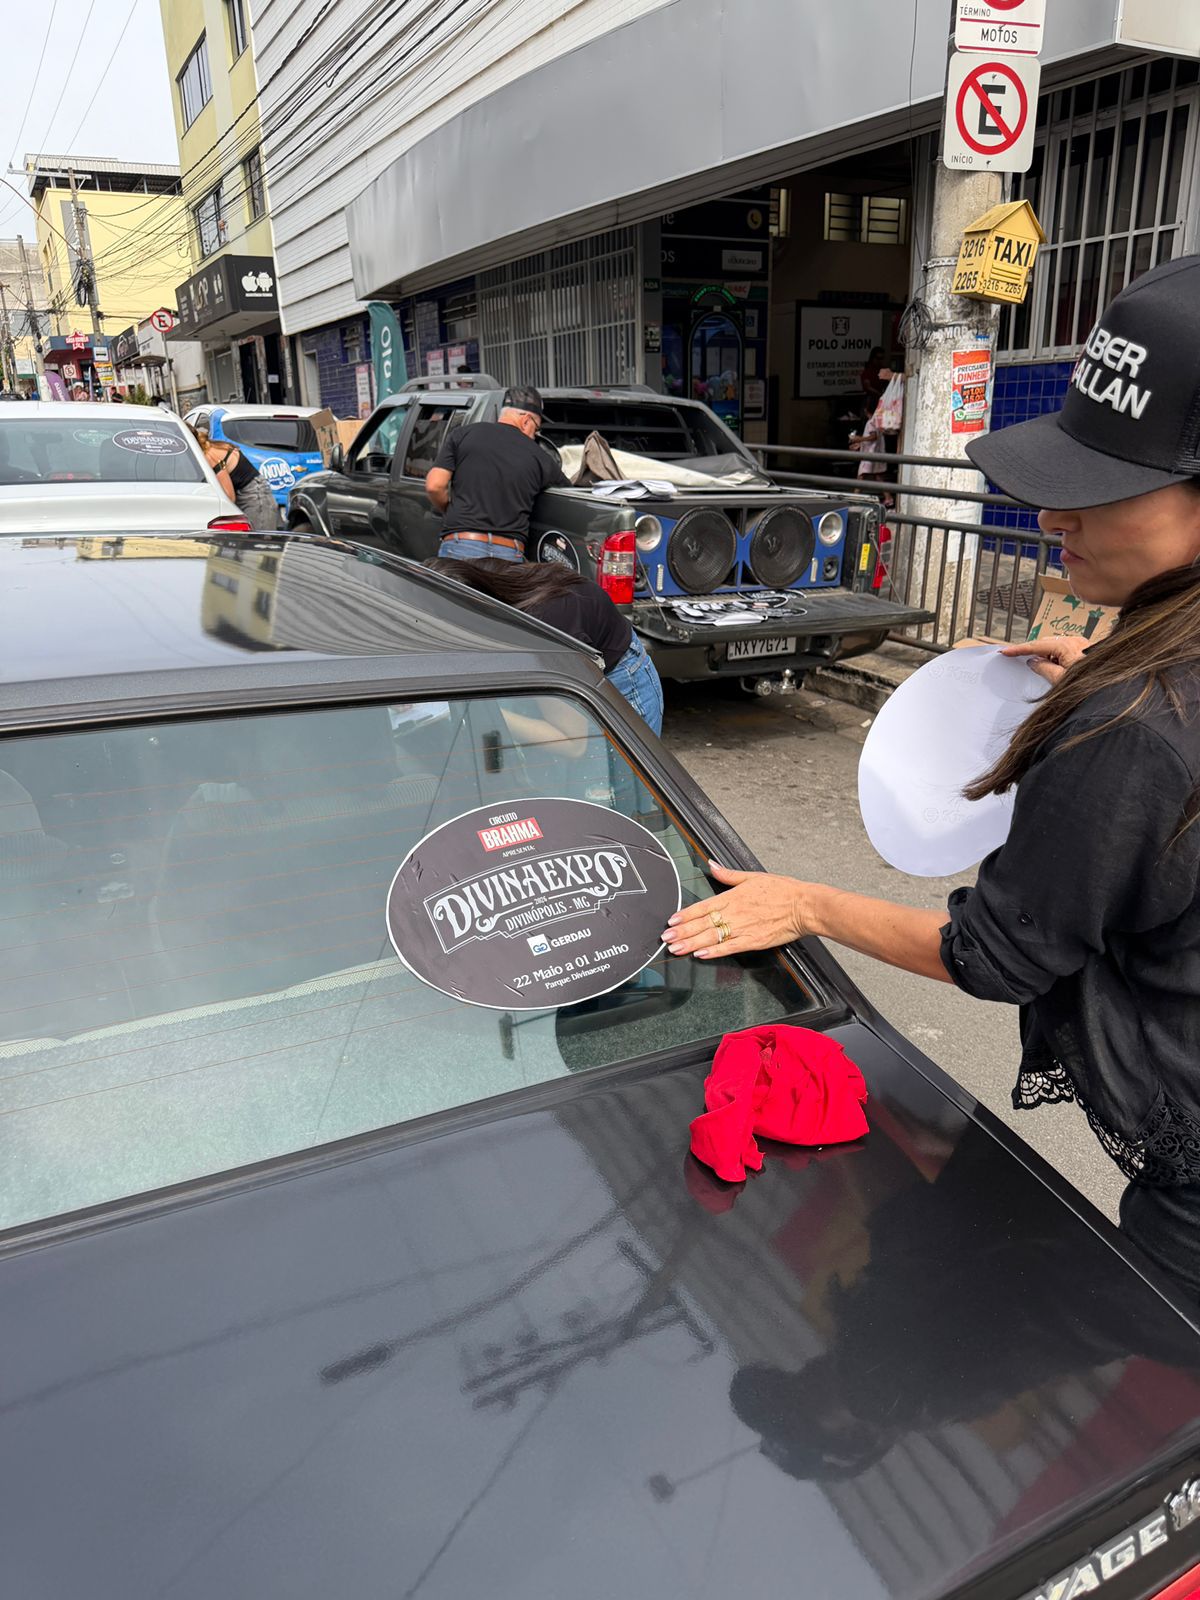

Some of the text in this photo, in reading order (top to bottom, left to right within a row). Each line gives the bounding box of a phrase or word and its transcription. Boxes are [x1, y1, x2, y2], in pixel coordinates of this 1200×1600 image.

[960, 4, 991, 17] TÉRMINO
[980, 28, 1018, 44] MOTOS
[978, 84, 1006, 136] E
[951, 153, 973, 164] INÍCIO
[962, 237, 986, 258] 3216
[993, 235, 1033, 267] TAXI
[955, 271, 978, 290] 2265
[982, 279, 1000, 291] 3216
[1004, 282, 1022, 295] 2265
[808, 338, 872, 350] POLO JHON
[1071, 358, 1151, 420] ALLAN
[735, 636, 788, 656] NXY7G71
[489, 812, 518, 826] CIRCUITO
[481, 820, 541, 849] BRAHMA
[433, 851, 628, 939] DIVINAEXPO
[504, 901, 568, 932] DIVINÓPOLIS
[572, 896, 591, 910] MG
[550, 928, 592, 948] GERDAU
[513, 944, 629, 988] 22 Maio a 01 Junho
[545, 963, 611, 989] Parque Divinaexpo
